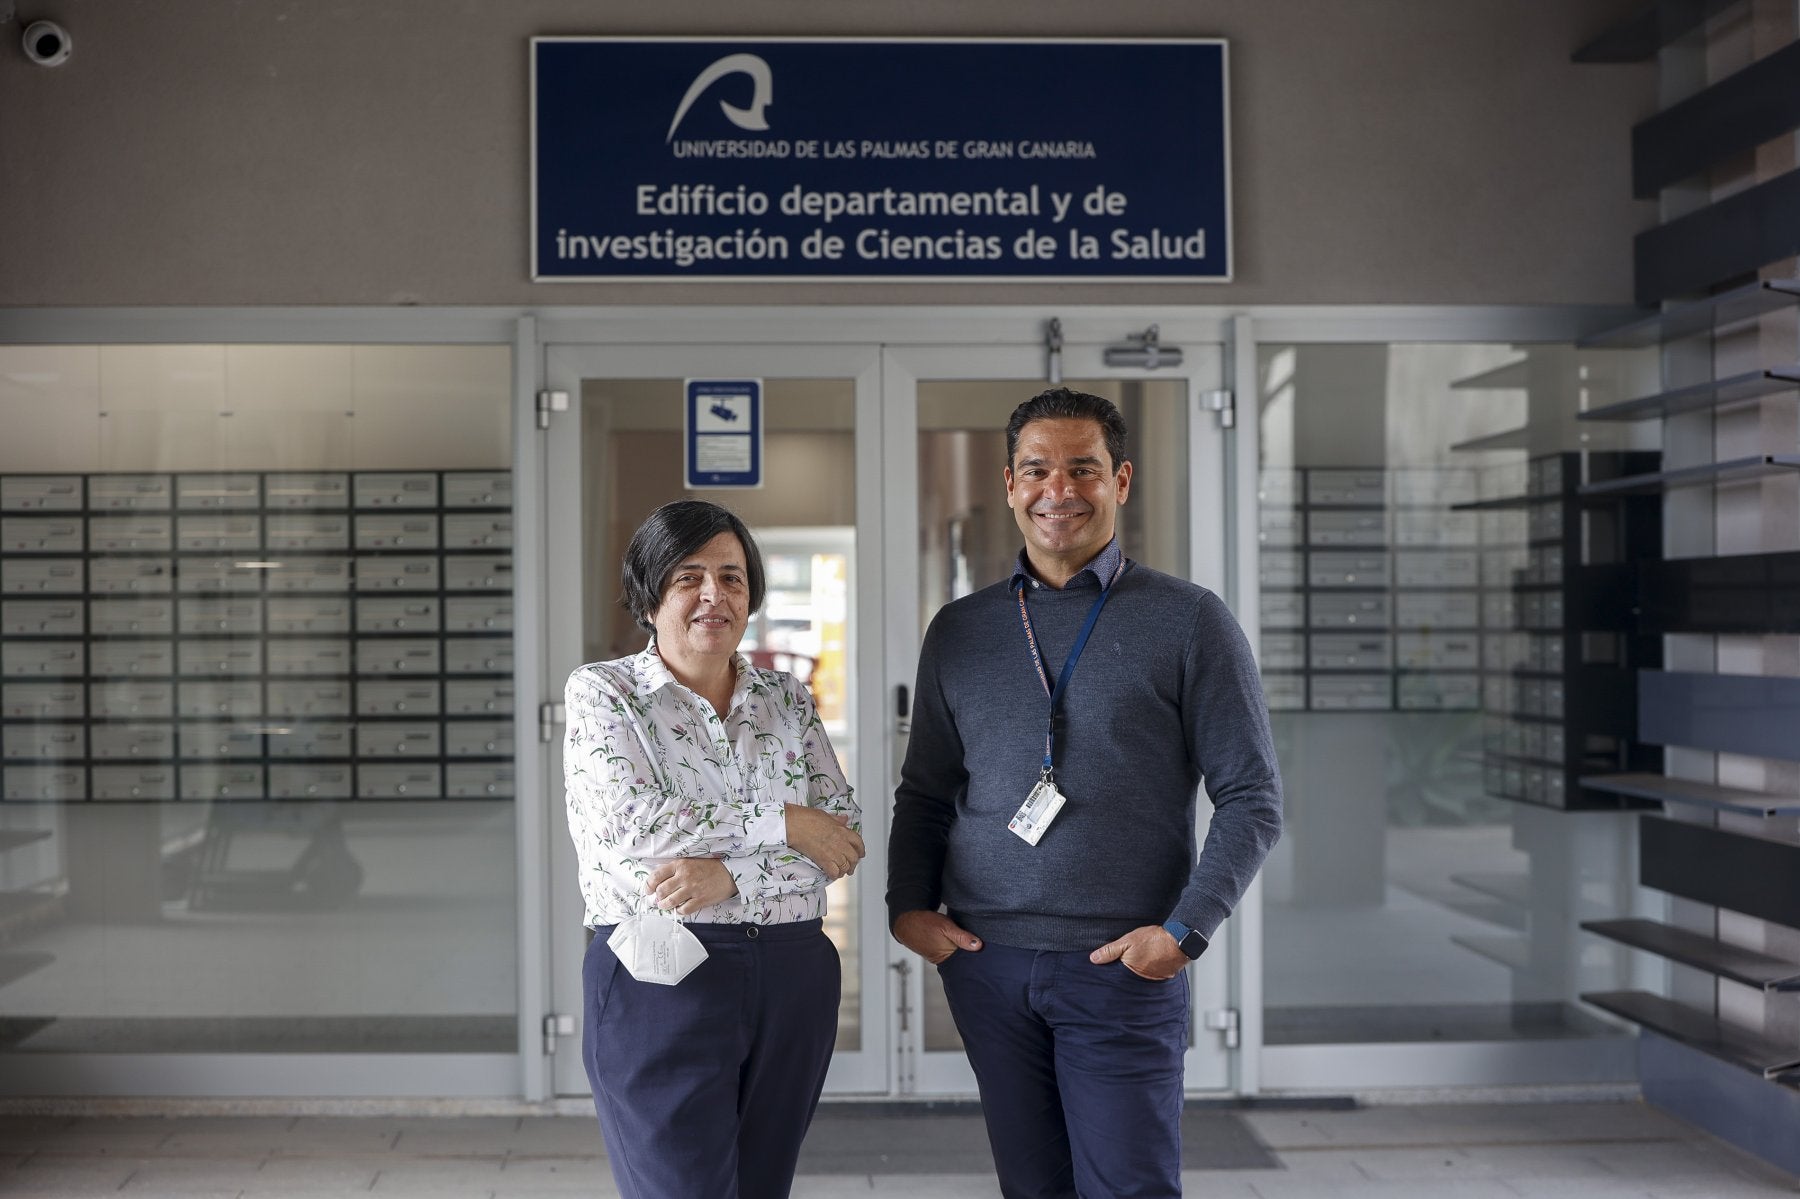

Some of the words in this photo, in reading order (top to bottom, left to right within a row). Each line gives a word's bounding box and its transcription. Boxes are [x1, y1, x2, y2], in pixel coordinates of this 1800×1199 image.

[673, 140, 790, 158] UNIVERSIDAD
[795, 140, 818, 158] DE
[824, 140, 856, 158] LAS
[861, 140, 930, 159] PALMAS
[935, 141, 958, 159] DE
[963, 141, 1013, 159] GRAN
[1018, 141, 1096, 159] CANARIA
[637, 184, 769, 216] Edificio
[780, 184, 1040, 223] departamental
[1051, 192, 1073, 223] y
[1083, 184, 1127, 216] de
[556, 228, 789, 267] investigación
[800, 228, 845, 260] de
[856, 228, 1003, 260] Ciencias
[1013, 228, 1058, 260] de
[1069, 228, 1100, 260] la
[1110, 228, 1206, 260] Salud
